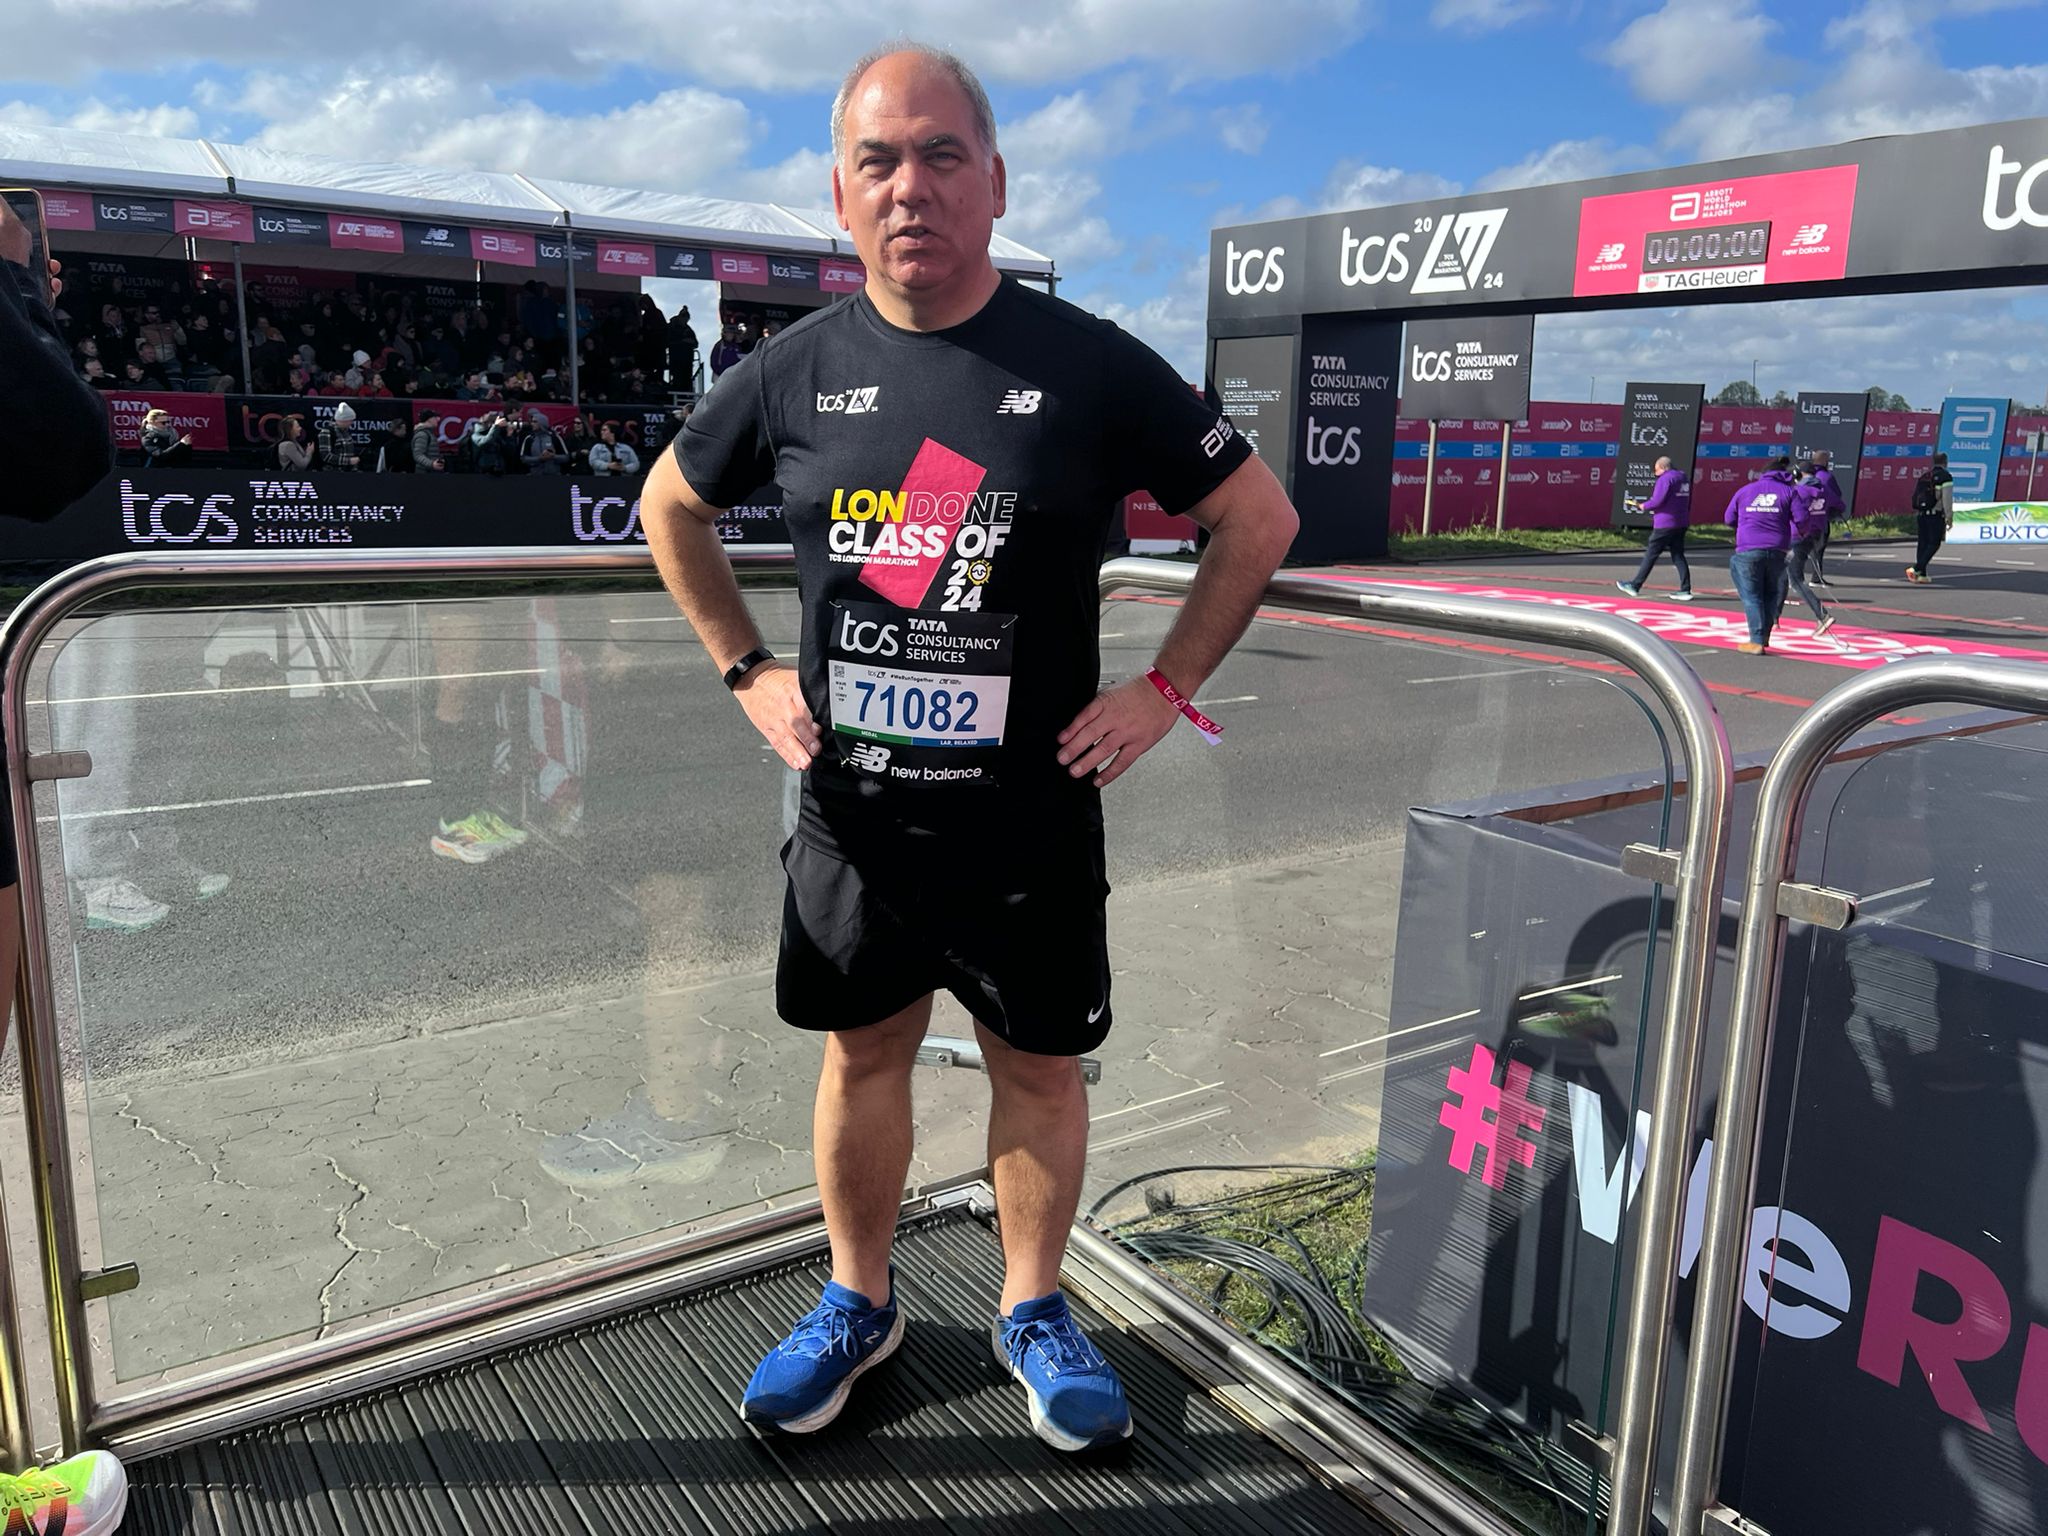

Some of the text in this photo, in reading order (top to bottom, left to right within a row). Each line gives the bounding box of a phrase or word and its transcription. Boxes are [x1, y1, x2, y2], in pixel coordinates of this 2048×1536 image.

[1703, 195, 1731, 204] WORLD
[1704, 188, 1734, 197] ABBOTT
[101, 204, 128, 220] tcs
[1702, 201, 1747, 211] MARATHON
[1702, 208, 1733, 218] MAJORS
[259, 217, 285, 232] tcs
[1414, 217, 1433, 233] 20
[540, 243, 562, 258] tcs
[1648, 229, 1766, 264] 00:00:00
[1781, 245, 1831, 257] new balance
[1340, 226, 1410, 286] tcs
[772, 264, 790, 278] tcs
[1225, 240, 1285, 295] tcs
[1484, 273, 1504, 288] 24
[1456, 342, 1482, 354] TATA
[1312, 355, 1346, 370] TATA
[1412, 344, 1452, 382] tcs
[1455, 354, 1519, 368] CONSULTANCY
[1310, 373, 1389, 390] CONSULTANCY
[1454, 369, 1494, 381] SERVICES
[816, 391, 845, 412] tcs
[1310, 391, 1361, 407] SERVICES
[312, 406, 339, 417] TAT
[1801, 400, 1840, 416] Lingo
[113, 415, 210, 428] CONTANCY
[643, 413, 666, 423] TAT
[1306, 416, 1361, 465] tcs
[1631, 422, 1668, 446] tcs
[249, 481, 319, 499] TATA
[119, 478, 239, 543] tcs
[252, 505, 405, 522] CONSULTANCY
[831, 488, 1018, 526] LONDONE
[1132, 502, 1164, 511] NIS
[253, 527, 353, 543] SERVICES
[828, 521, 1012, 559] CLASS OF
[828, 553, 919, 567] TCS LONDON MARATHON
[940, 585, 983, 612] 24
[907, 618, 948, 632] TATA
[840, 610, 899, 657] tcs
[907, 633, 1001, 651] CONSULTANCY
[906, 648, 966, 664] SERVICES
[855, 680, 979, 732] 71082
[891, 766, 982, 781] new balance
